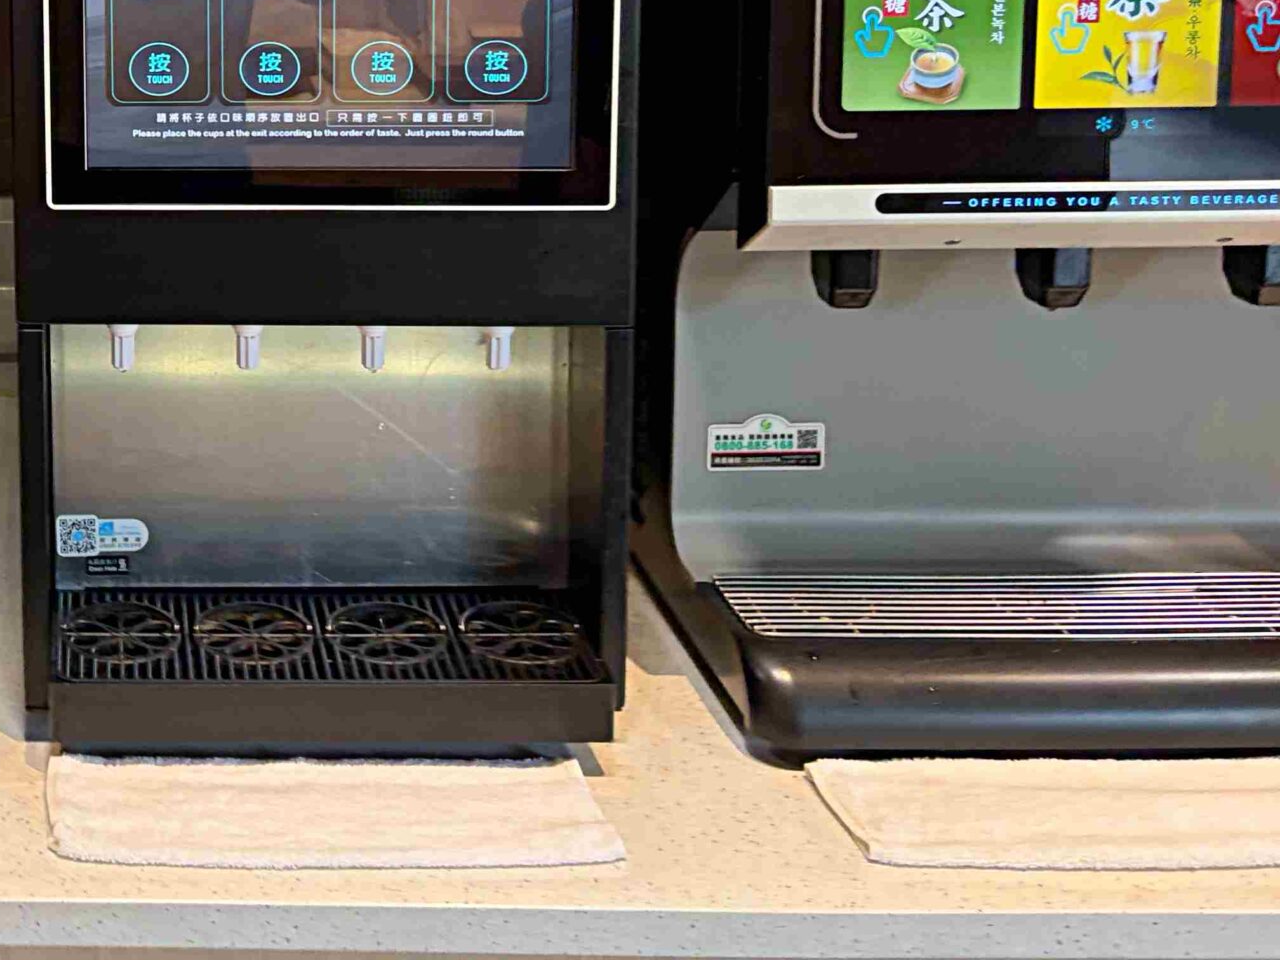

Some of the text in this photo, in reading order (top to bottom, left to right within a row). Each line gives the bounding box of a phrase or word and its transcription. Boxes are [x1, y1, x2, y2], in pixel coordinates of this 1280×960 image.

[148, 53, 171, 73] 按
[259, 52, 282, 72] 按
[371, 51, 395, 71] 按
[485, 51, 508, 71] 按
[147, 75, 173, 84] TOUCH
[257, 74, 283, 84] TOUCH
[369, 74, 396, 83] TOUCH
[483, 74, 510, 83] TOUCH
[156, 112, 320, 123] 請將杯子依口味順序放置出口
[133, 129, 524, 139] Please place the cups at the exit according to the order of taste. Just press the round button
[968, 194, 1279, 208] OFFERING YOU A TASTY BEVERAGE
